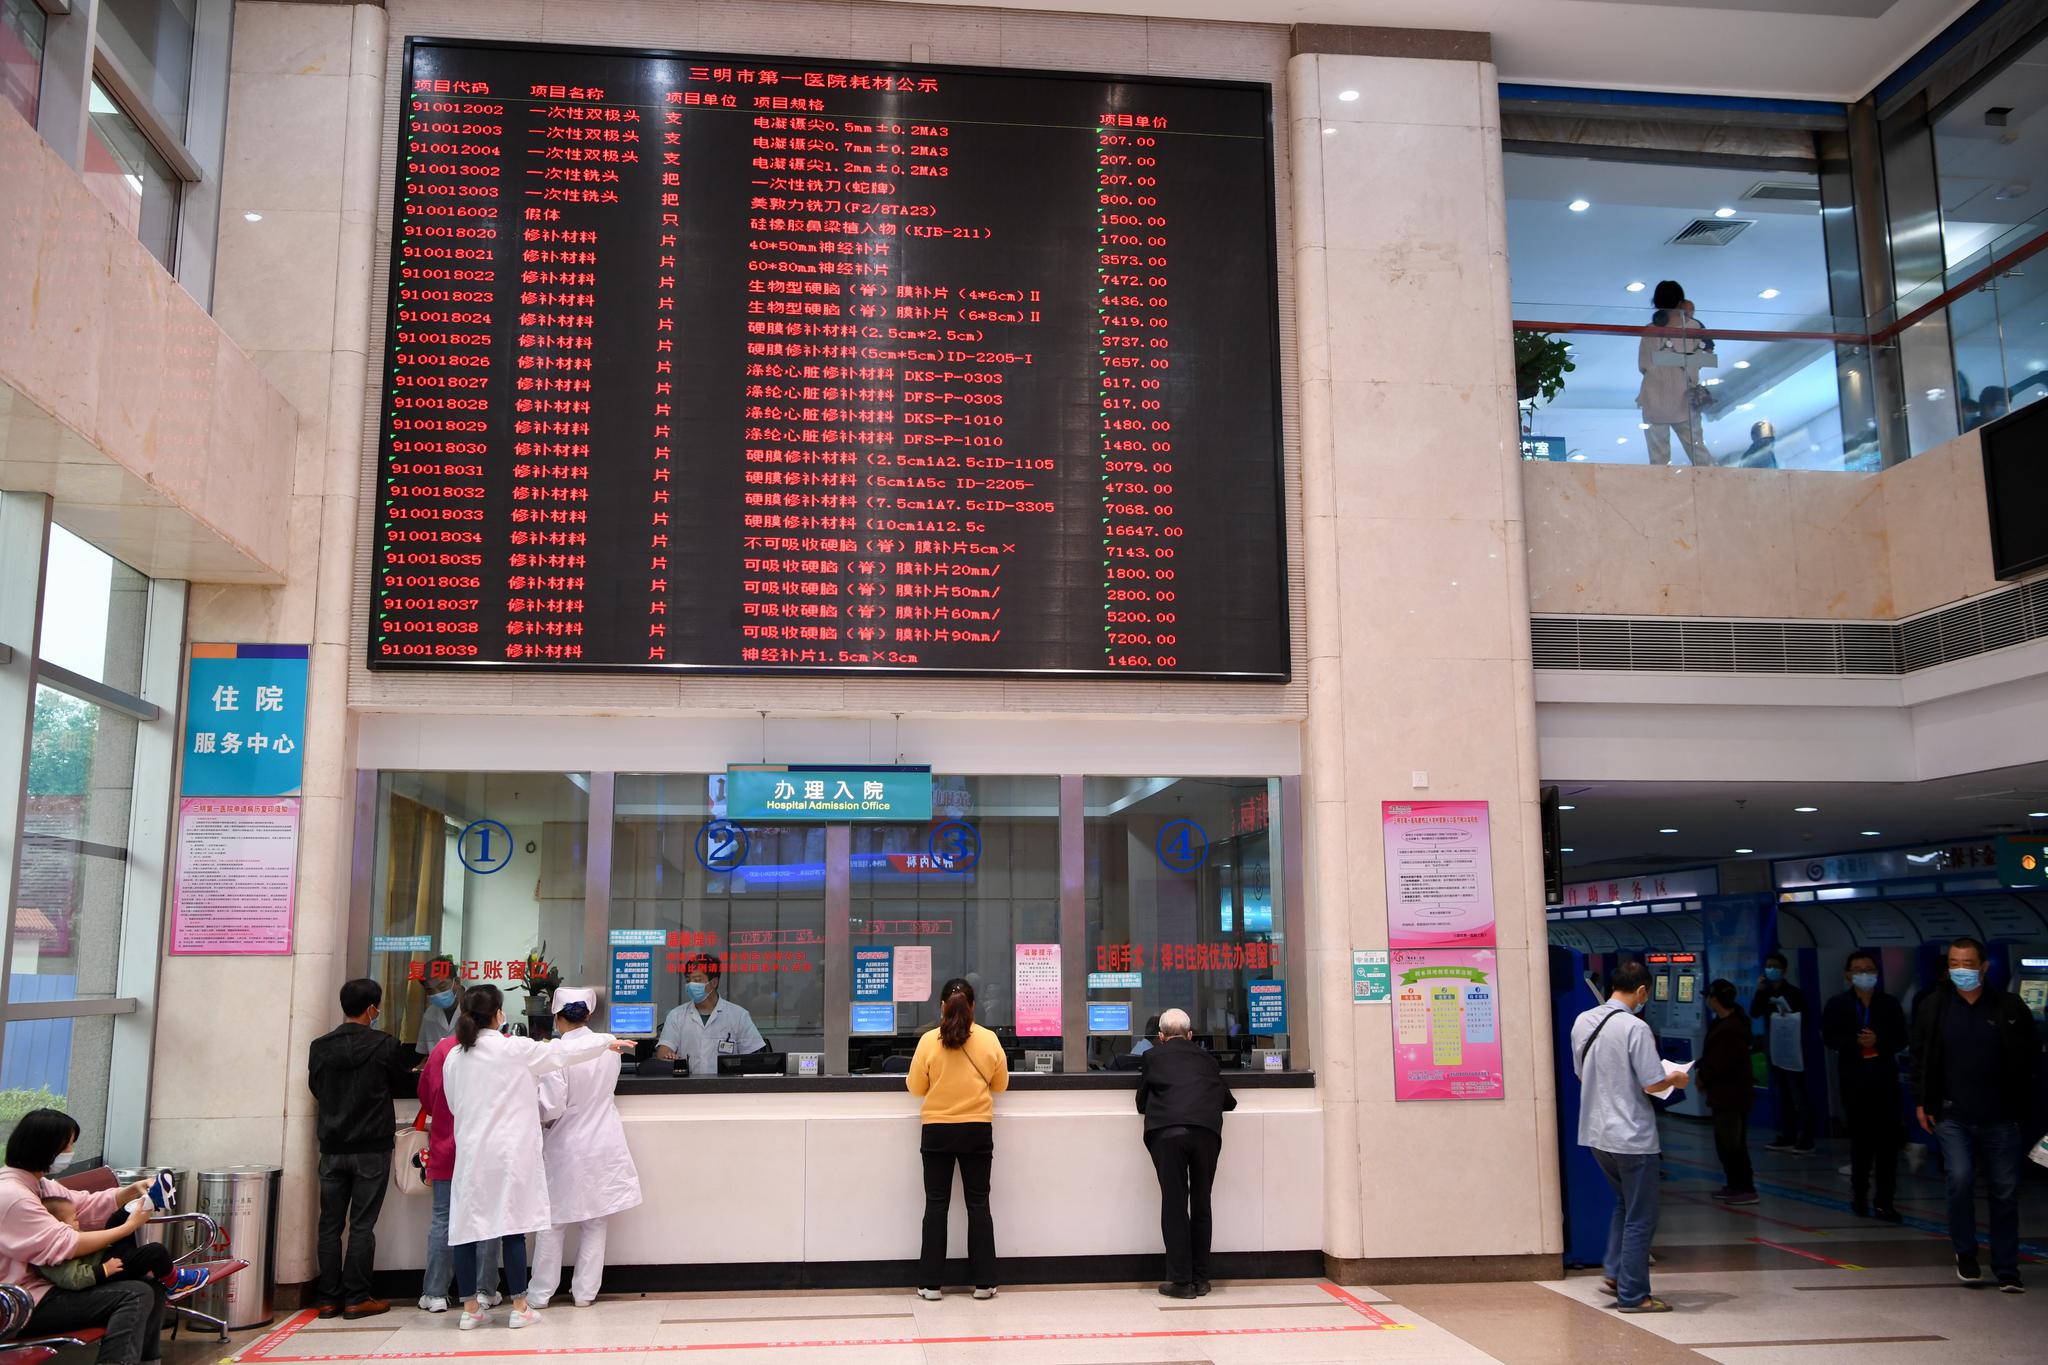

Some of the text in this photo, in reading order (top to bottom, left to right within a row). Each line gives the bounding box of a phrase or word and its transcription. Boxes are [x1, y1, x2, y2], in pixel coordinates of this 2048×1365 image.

[690, 68, 938, 92] 三明市第一医院耗材公示
[416, 80, 1167, 128] 项目代码 项目名称 项目单位 项目规格 项目单价
[413, 101, 503, 114] 910012002
[530, 106, 640, 122] 一次性双极头
[667, 112, 682, 124] 支
[1101, 135, 1155, 147] 207.00
[412, 122, 502, 135] 910012003
[529, 126, 639, 142] 一次性双极头
[665, 132, 680, 144] 支
[1101, 155, 1155, 166] 207.00
[410, 142, 500, 156] 910012004
[528, 147, 638, 162] 一次性双极头
[664, 152, 680, 165] 支
[1101, 174, 1156, 186] 207.00
[409, 163, 1156, 206] 910013002 一次性铣头 把 一次性铣刀(蛇牌) 800.00
[408, 184, 1166, 226] 910013003 一次性铣头 把 美敦力铣刀(F2/8TA23) 1500.00
[406, 204, 497, 218] 910016002
[525, 208, 560, 221] 假体
[663, 214, 678, 225] 只
[1102, 234, 1166, 246] 1700.00
[405, 226, 496, 238] 910018020
[524, 229, 597, 244] 修补材料
[661, 235, 676, 246] 片
[1101, 255, 1167, 266] 3573.00
[404, 247, 493, 260] 910018021
[523, 250, 596, 264] 修补材料
[1102, 275, 1167, 286] 7472.00
[402, 268, 495, 281] 910018022
[522, 270, 595, 286] 修补材料
[1102, 296, 1168, 307] 4436.00
[401, 290, 493, 302] 910018023
[521, 292, 595, 306] 修补材料
[1102, 316, 1168, 328] 7419.00
[400, 311, 491, 324] 910018024
[520, 313, 594, 328] 修补材料
[1103, 336, 1168, 348] 3737.00
[398, 333, 491, 345] 910018025
[519, 334, 592, 349] 修补材料
[657, 340, 672, 351] 片
[1104, 356, 1169, 368] 7657.00
[397, 354, 1160, 389] 910018026 修补材料 涤纶心脏修补材料 DKS-P-0303 617.00
[396, 375, 1160, 410] 910018027 修补材料 涤纶心脏修补材料 DFS-P-0303 617.00
[395, 397, 1170, 431] 910018028 修补材料 涤纶心脏修补材料 DKS-P-1010 1480.00
[394, 419, 1171, 452] 910018029 修补材料 涤纶心脏修补材料 DFS-P-1010 1480.00
[393, 441, 487, 454] 910018030
[515, 442, 590, 457] 修补材料
[656, 446, 670, 459] 片
[1105, 461, 1172, 472] 3079.00
[392, 464, 483, 476] 910018031
[513, 464, 588, 479] 修补材料
[1105, 482, 1172, 494] 4730.00
[390, 486, 485, 498] 910018032
[513, 486, 588, 501] 修补材料
[1106, 504, 1173, 516] 7068.00
[389, 508, 483, 520] 910018033
[512, 509, 587, 523] 修补材料
[1106, 525, 1183, 536] 16647.00
[388, 531, 482, 543] 910018034
[511, 531, 586, 546] 修补材料
[652, 534, 668, 547] 片
[1107, 546, 1174, 558] 7143.00
[387, 553, 481, 565] 910018035
[509, 554, 586, 568] 修补材料
[1108, 568, 1174, 580] 1800.00
[385, 576, 480, 588] 910018036
[508, 576, 585, 590] 修补材料
[1107, 589, 1176, 601] 2800.00
[384, 599, 479, 610] 910018037
[507, 598, 584, 613] 修补材料
[1108, 611, 1175, 623] 5200.00
[383, 621, 478, 633] 910018038
[506, 621, 583, 636] 修补材料
[1109, 633, 1176, 645] 7200.00
[382, 644, 478, 655] 910018039
[505, 644, 582, 658] 修补材料
[649, 647, 665, 659] 片
[1109, 655, 1176, 666] 1460.00
[211, 685, 283, 712] 住院
[194, 732, 296, 755] 服务中心
[766, 801, 891, 812] Hospital Admission Office
[773, 779, 885, 802] 办理入院
[407, 960, 550, 982] 复印 记账窗口
[1096, 943, 1145, 972] 日间手术
